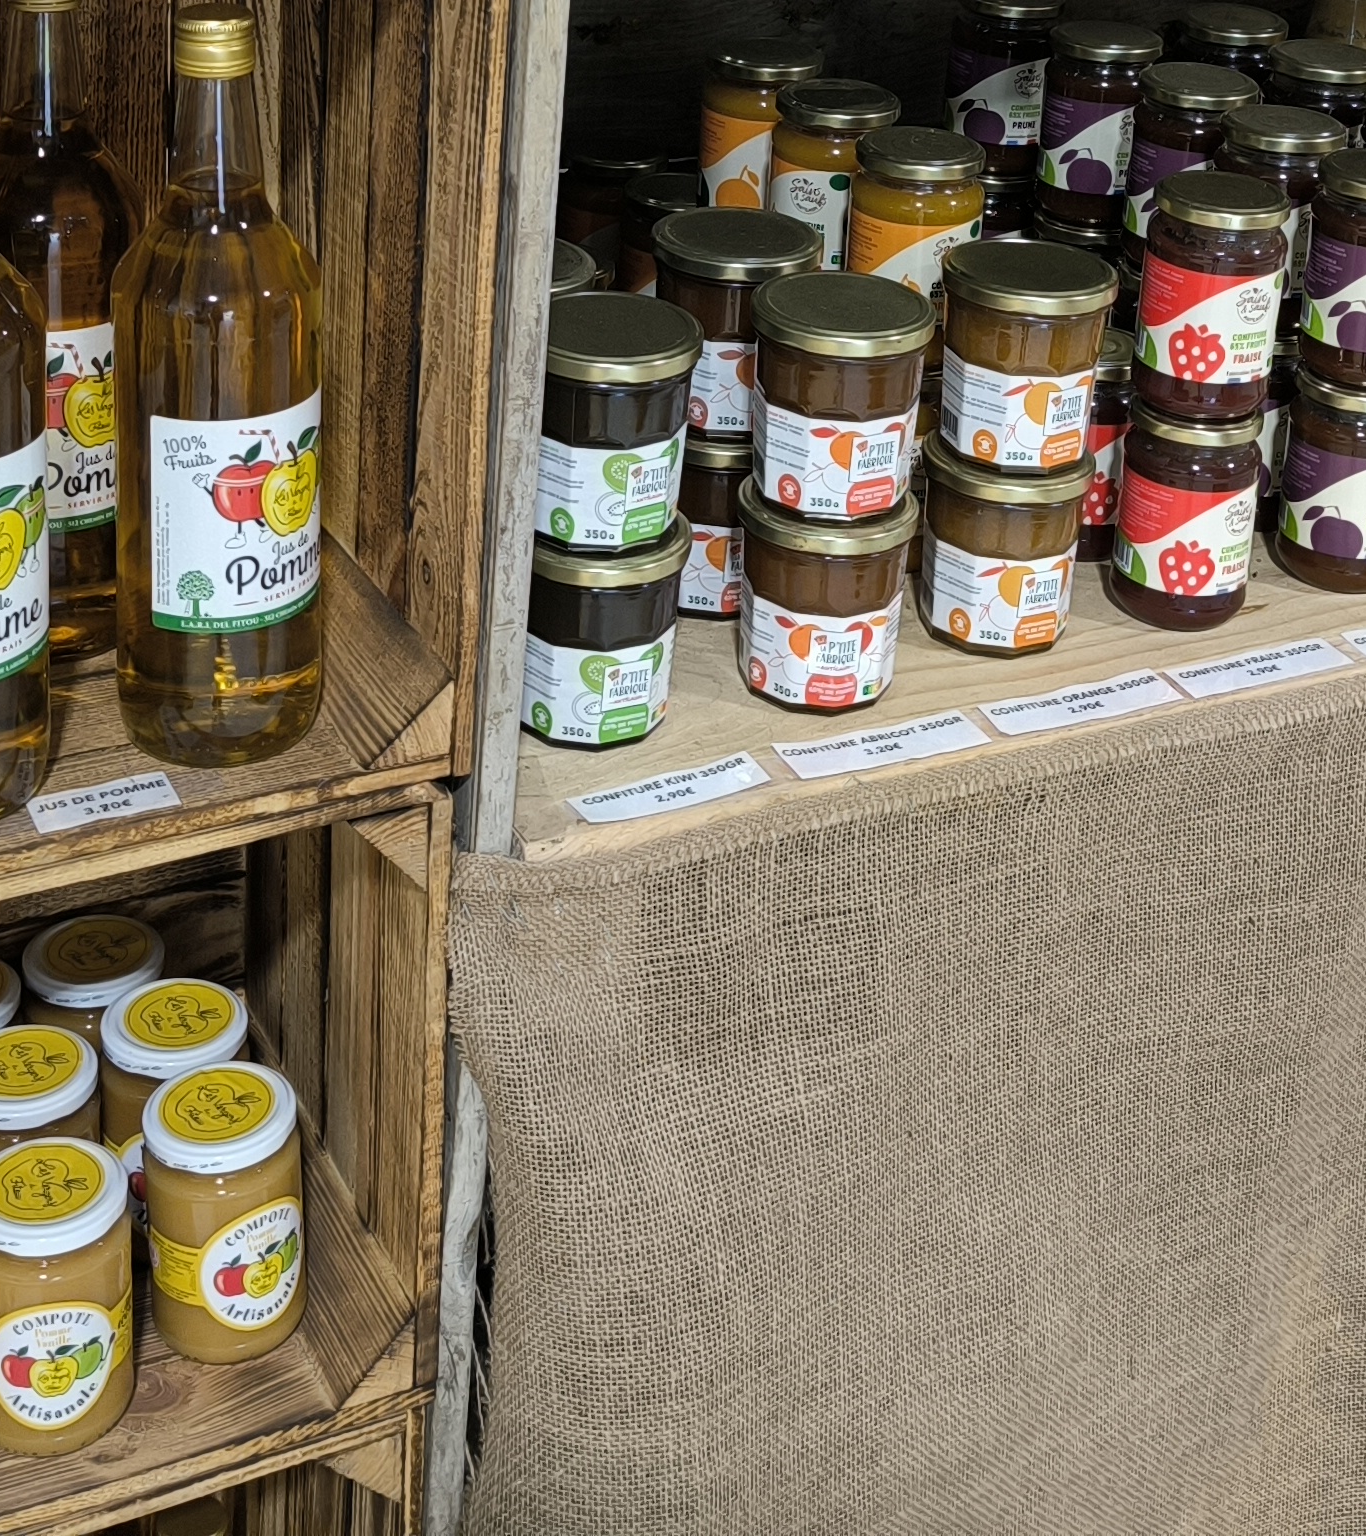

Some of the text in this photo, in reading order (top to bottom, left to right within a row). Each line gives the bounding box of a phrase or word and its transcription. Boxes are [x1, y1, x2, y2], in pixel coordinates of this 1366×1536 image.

[76, 451, 103, 474] Jus
[163, 435, 207, 454] 100%
[164, 454, 216, 470] Fruits
[272, 534, 309, 564] Jus de
[1178, 642, 1324, 679] CONFITURE FRAISE 350GR
[990, 674, 1159, 717] CONFITURE ORANGE 350GR
[782, 715, 964, 757] CONFITURE ABRICOT 350GR
[36, 778, 167, 814] JUS DE POMME
[582, 757, 746, 806] CONFITURE KIWI 350GR
[655, 786, 696, 803] 2,90€
[226, 1208, 291, 1246] COMPOTE
[220, 1273, 297, 1321] Artisanale
[12, 1311, 93, 1336] COMPOTE
[5, 1382, 98, 1421] Artisanale
